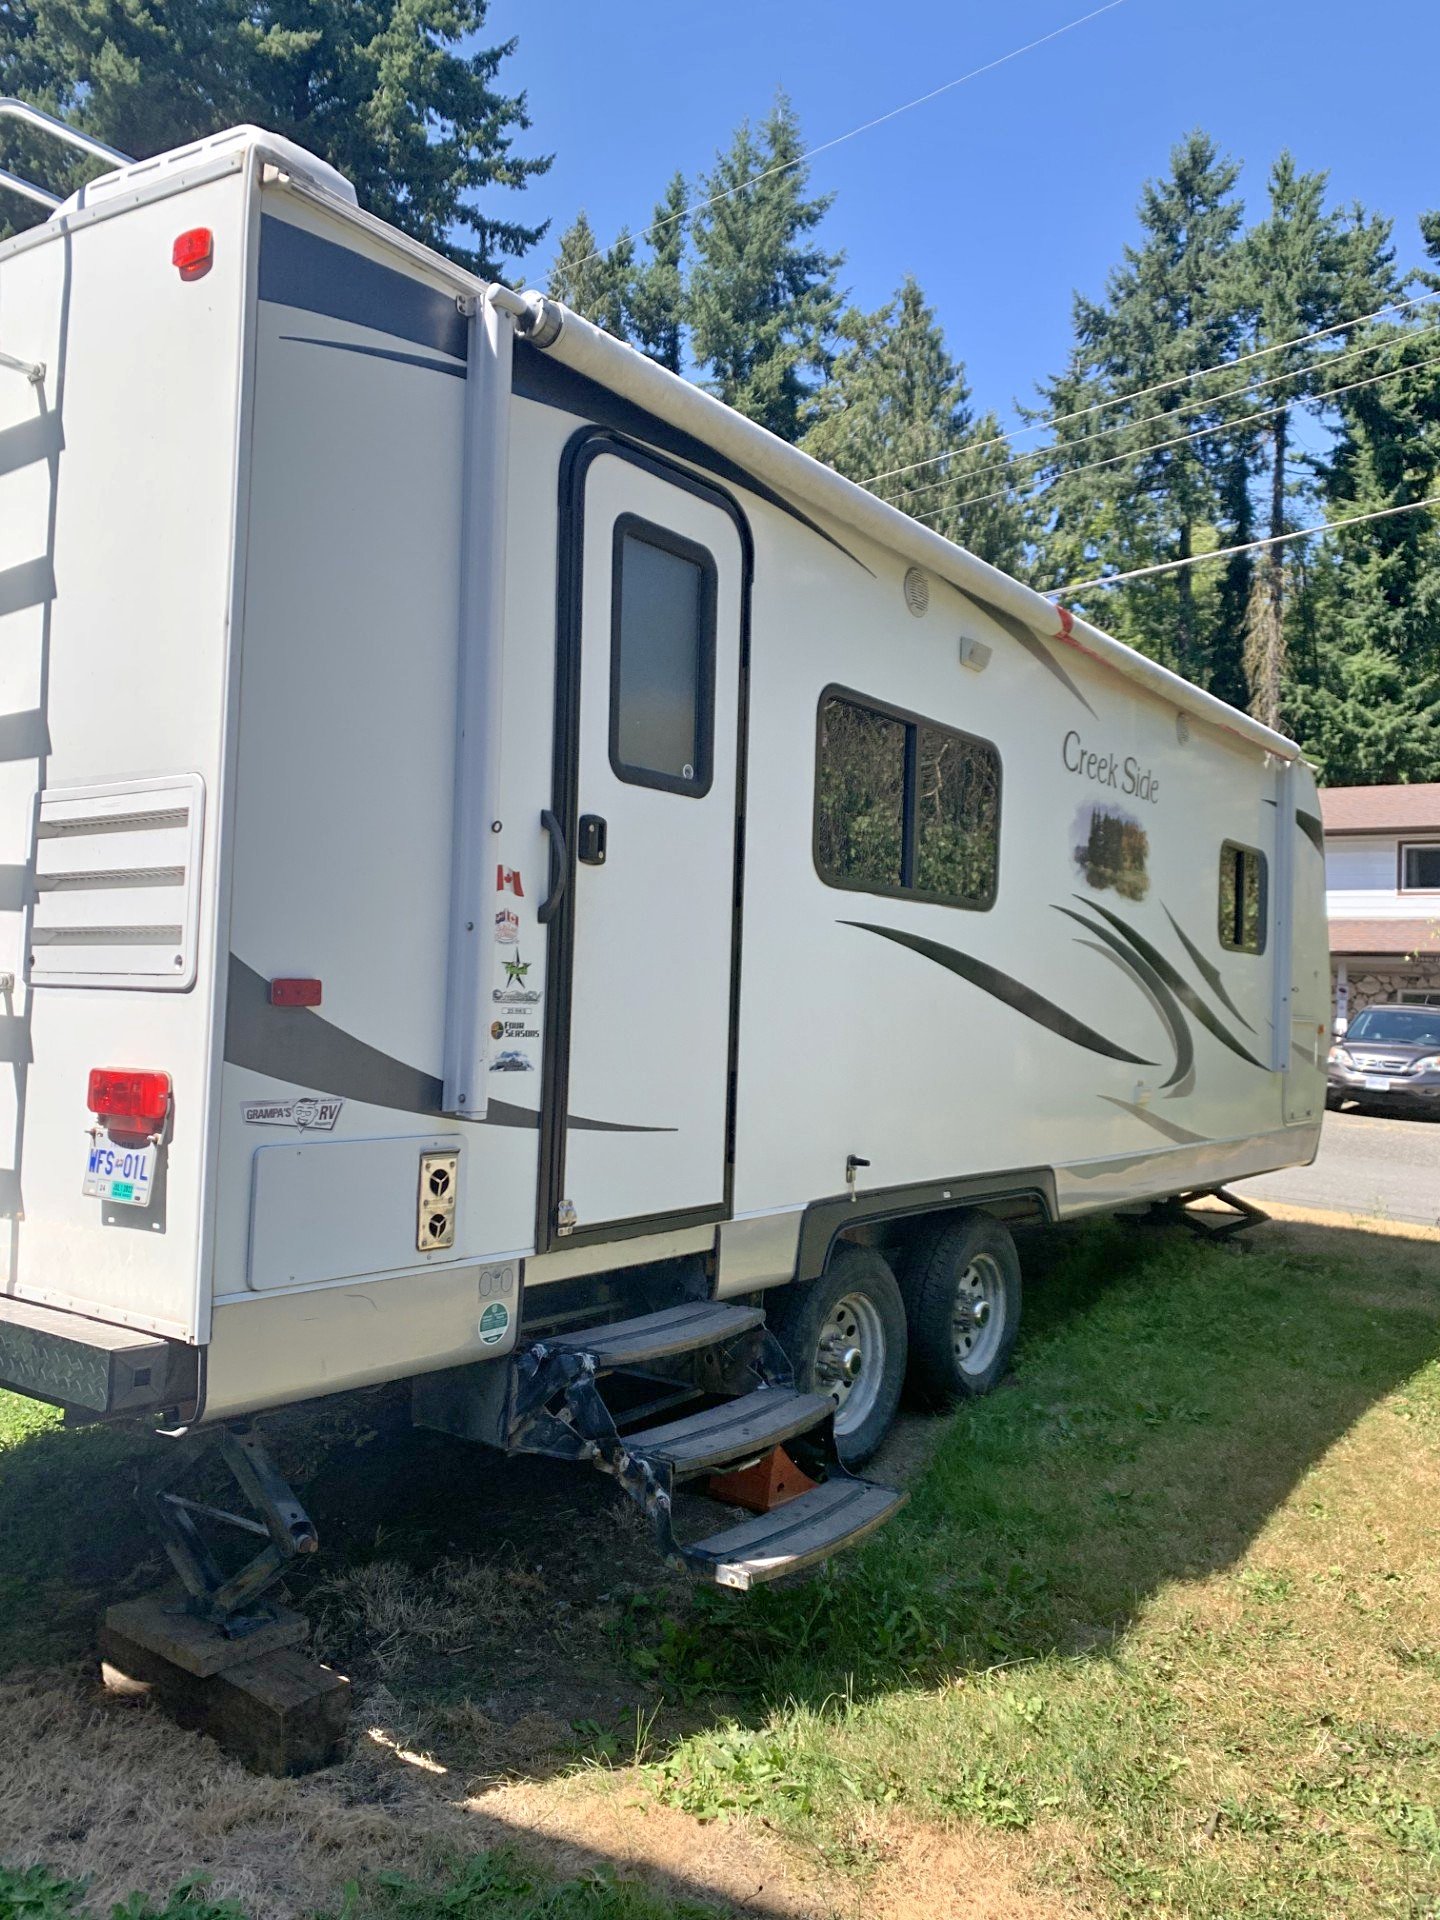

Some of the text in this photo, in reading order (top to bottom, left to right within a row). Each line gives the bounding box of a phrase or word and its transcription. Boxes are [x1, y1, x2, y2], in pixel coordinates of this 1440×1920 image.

[1062, 730, 1160, 804] Creek Side
[246, 1104, 338, 1121] GRAMPA'S RV
[88, 1148, 115, 1175] WFS
